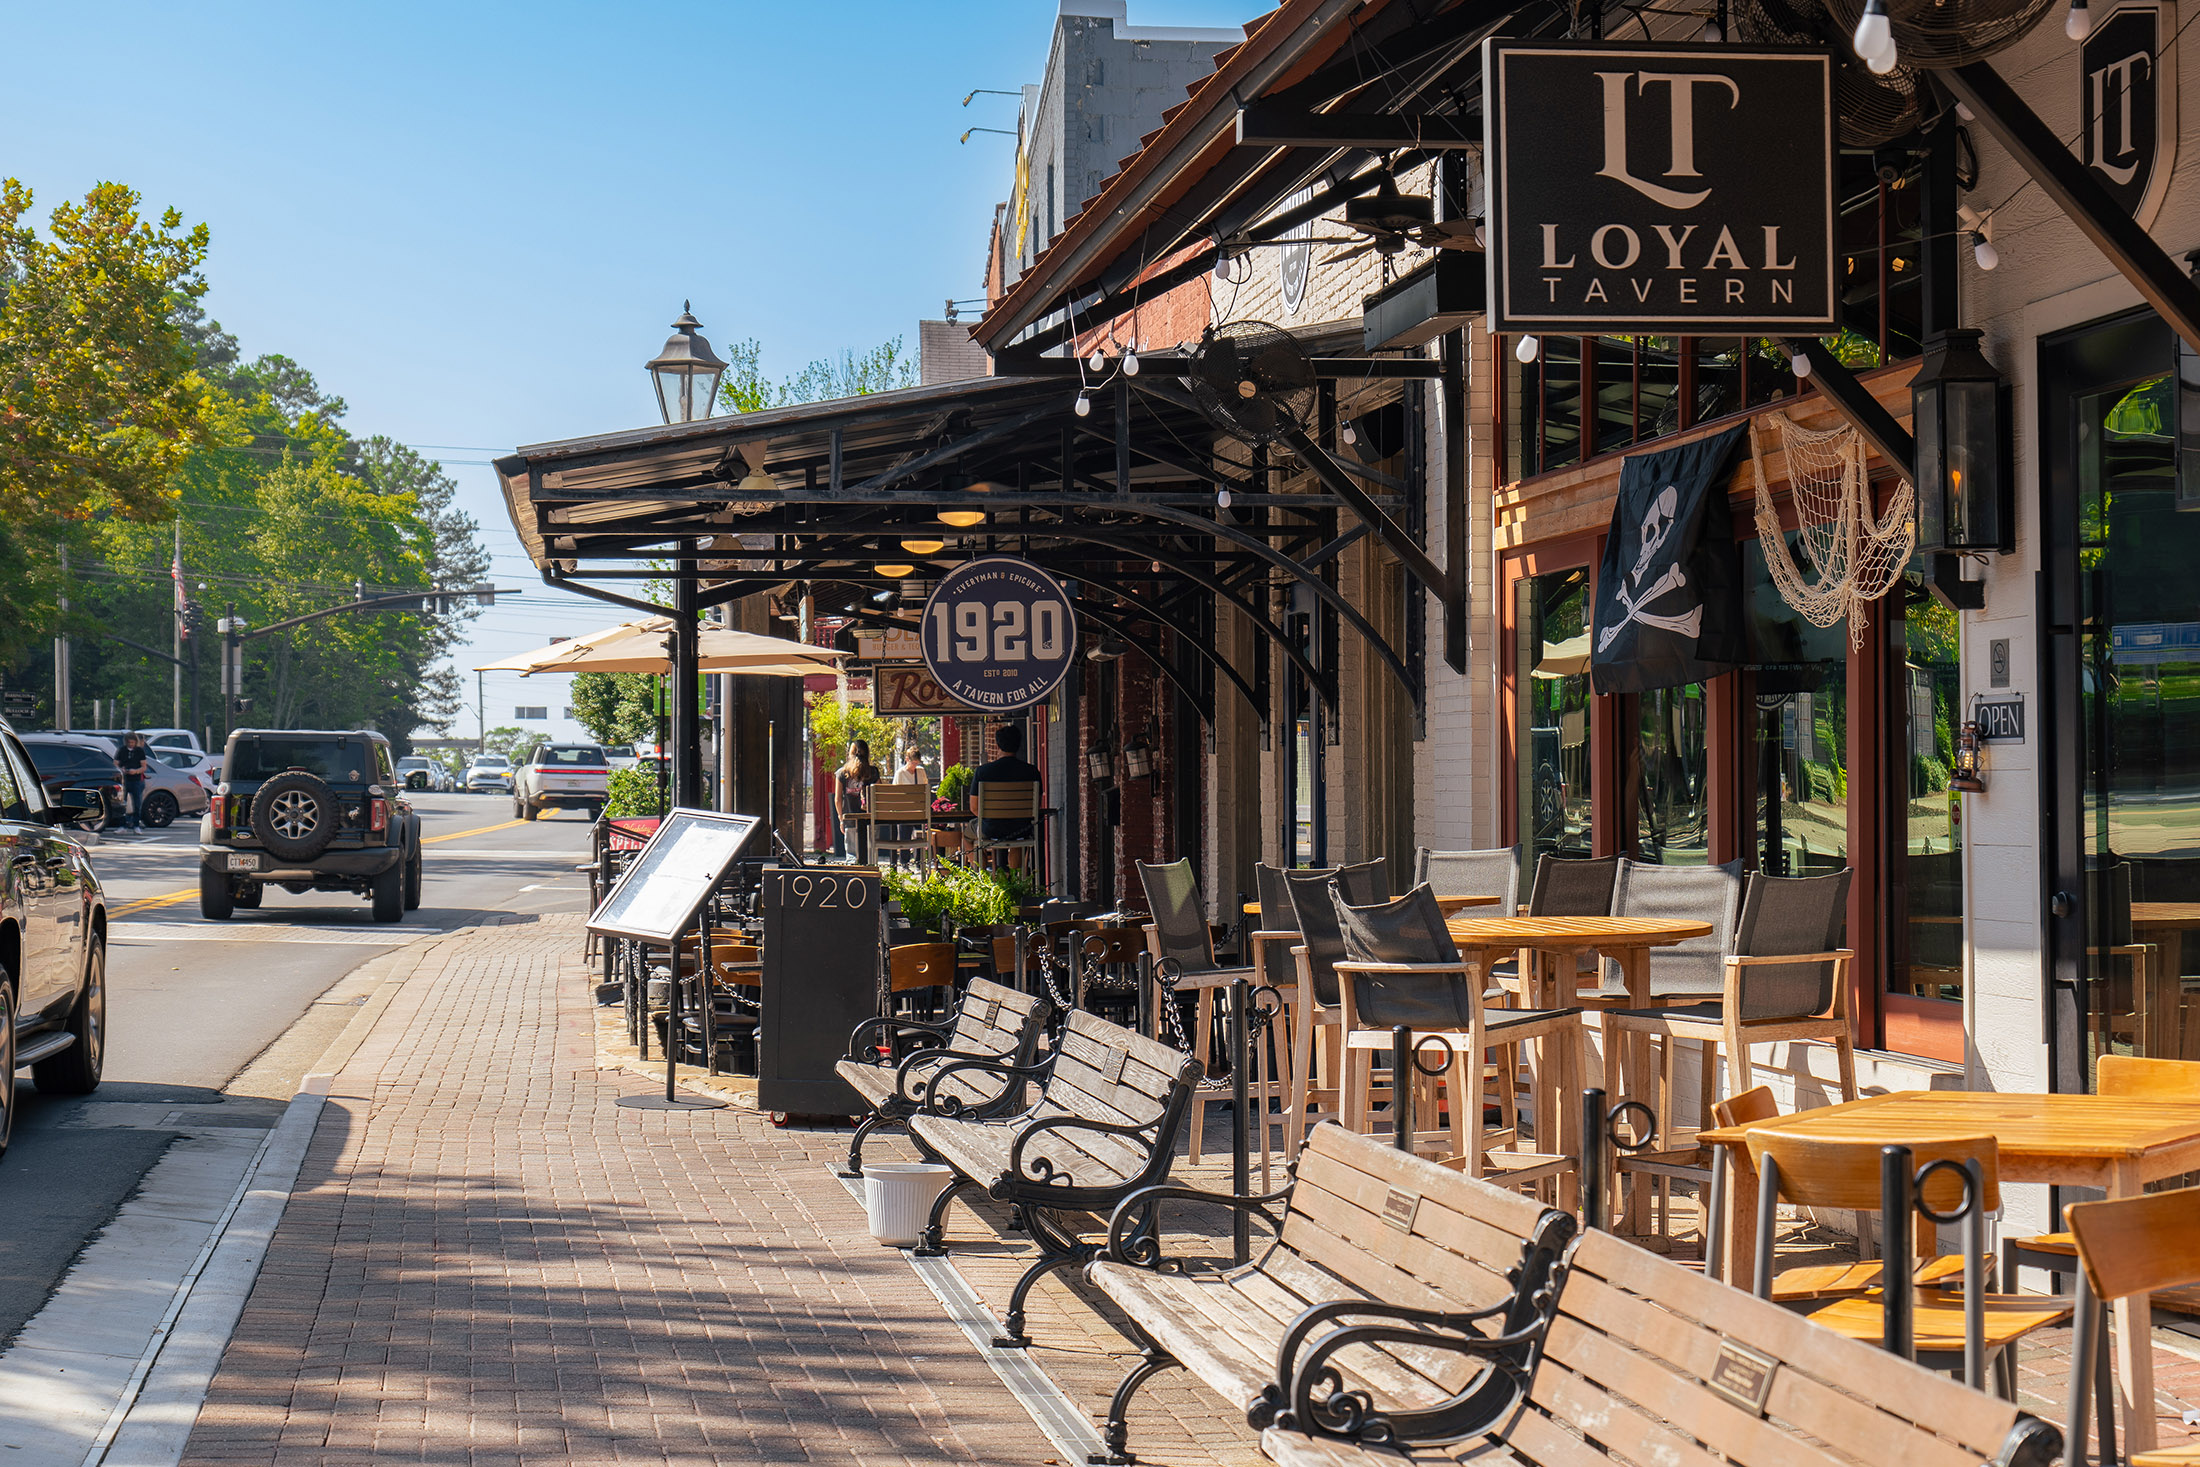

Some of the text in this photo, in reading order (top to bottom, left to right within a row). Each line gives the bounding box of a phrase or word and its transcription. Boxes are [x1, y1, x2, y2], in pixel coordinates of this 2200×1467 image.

[2089, 50, 2151, 185] LT
[1594, 70, 1740, 209] LT
[1539, 223, 1798, 271] LOYAL
[1542, 277, 1794, 304] TAVERN
[955, 571, 998, 594] EVERYMAN
[1008, 572, 1042, 593] EPICURE
[872, 643, 899, 651] BUGER
[931, 600, 1065, 662] 1920
[1002, 668, 1018, 677] 2010
[952, 676, 1049, 704] A TAVERN FOR ALL
[1979, 705, 2020, 737] OPEN
[776, 874, 867, 909] 1920
